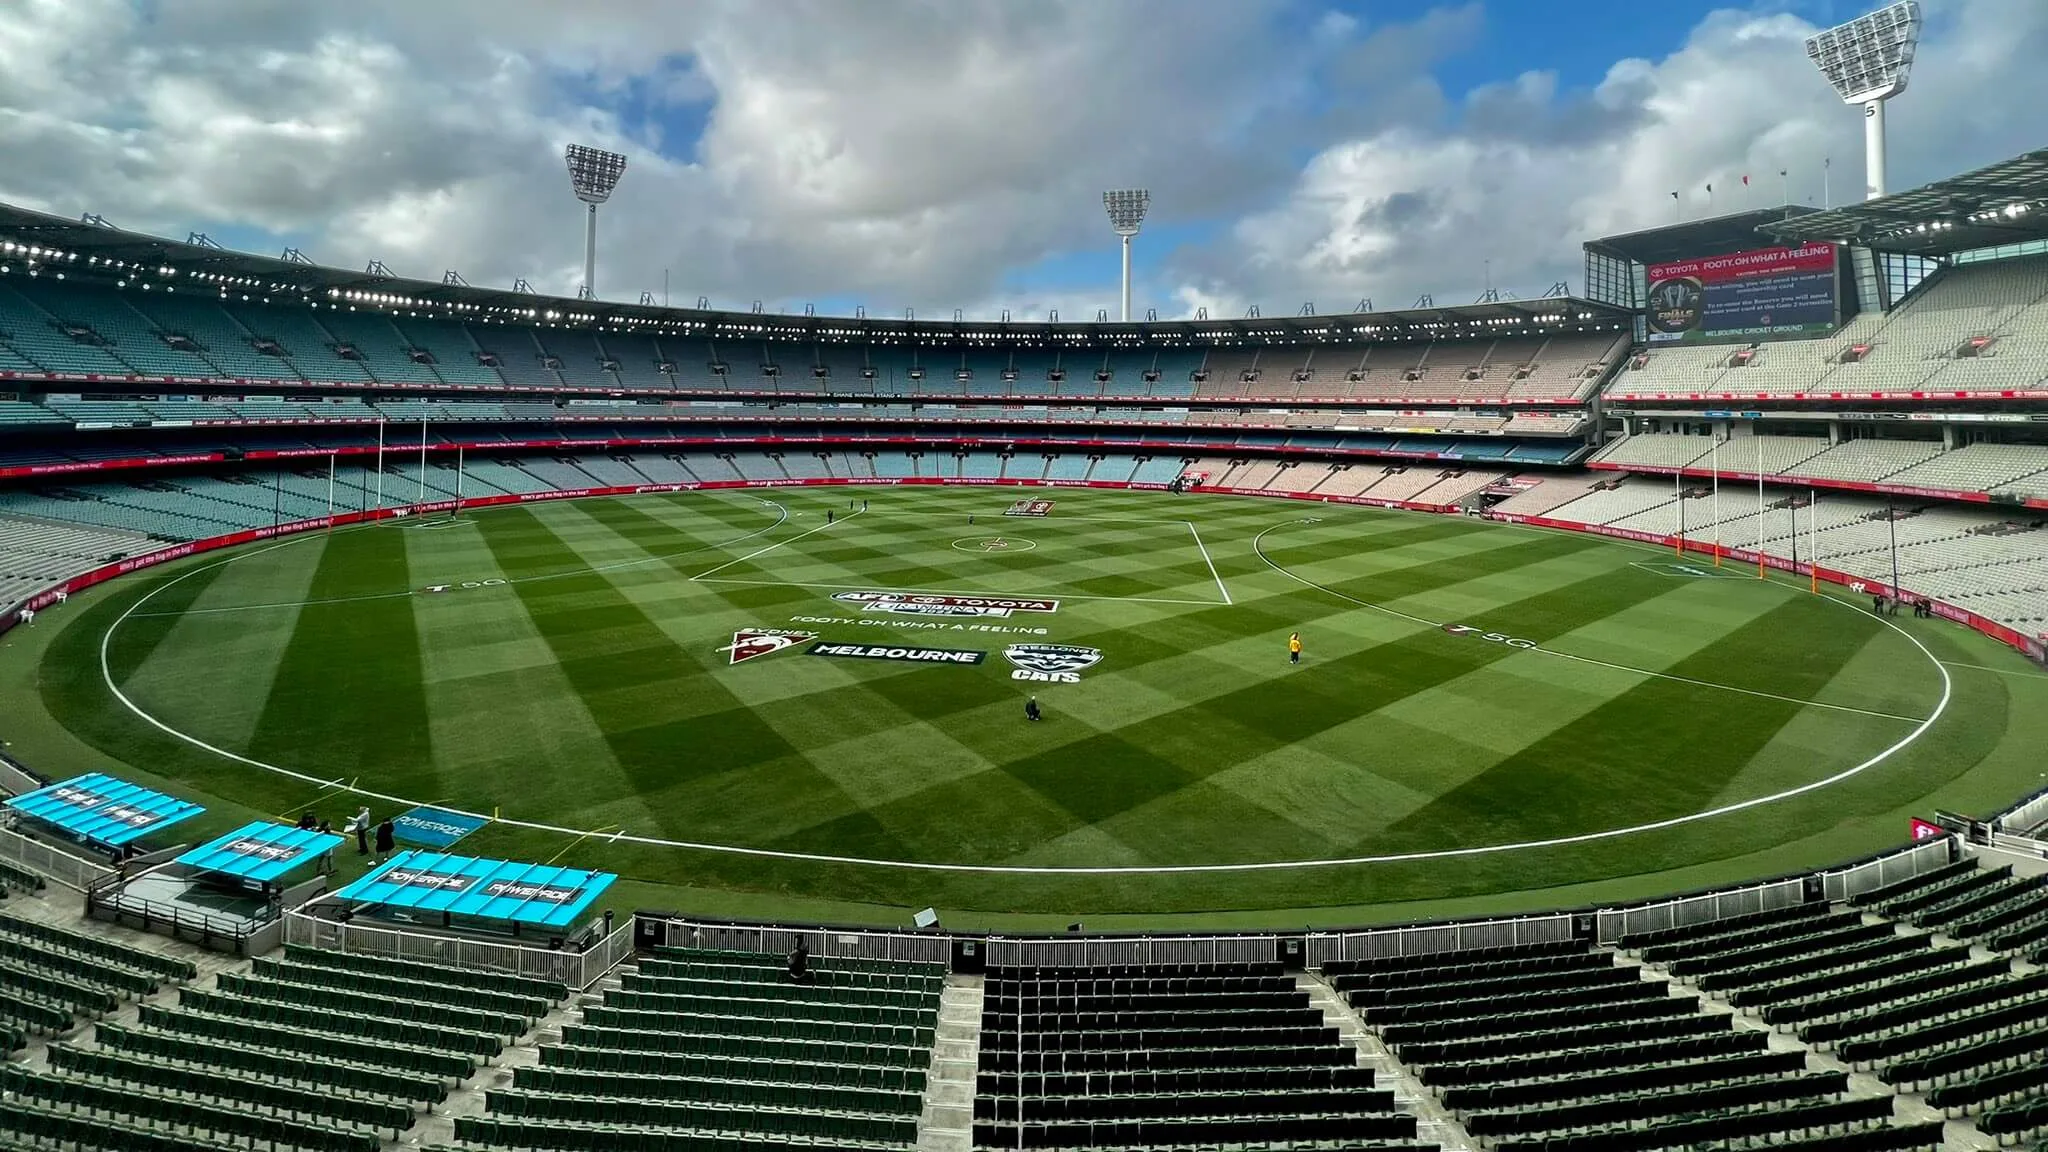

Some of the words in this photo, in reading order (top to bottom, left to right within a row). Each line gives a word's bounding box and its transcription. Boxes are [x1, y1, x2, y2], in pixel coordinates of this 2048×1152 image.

[1865, 105, 1876, 117] 5
[1665, 264, 1698, 274] TOYOTA
[1750, 253, 1778, 263] WHAT
[1780, 251, 1787, 260] A
[1788, 245, 1829, 257] FEELING
[1657, 309, 1694, 320] FINALS
[1773, 325, 1803, 333] GROUND
[842, 592, 899, 601] AFL
[953, 598, 1047, 609] TOYOTA
[741, 627, 820, 636] SYDNEY
[892, 621, 948, 630] WHAT
[968, 625, 1048, 635] FEELING
[814, 644, 979, 663] MELBOURNE
[1018, 645, 1090, 654] GEELONG
[1011, 669, 1081, 683] CATS
[399, 815, 469, 837] POWERADE
